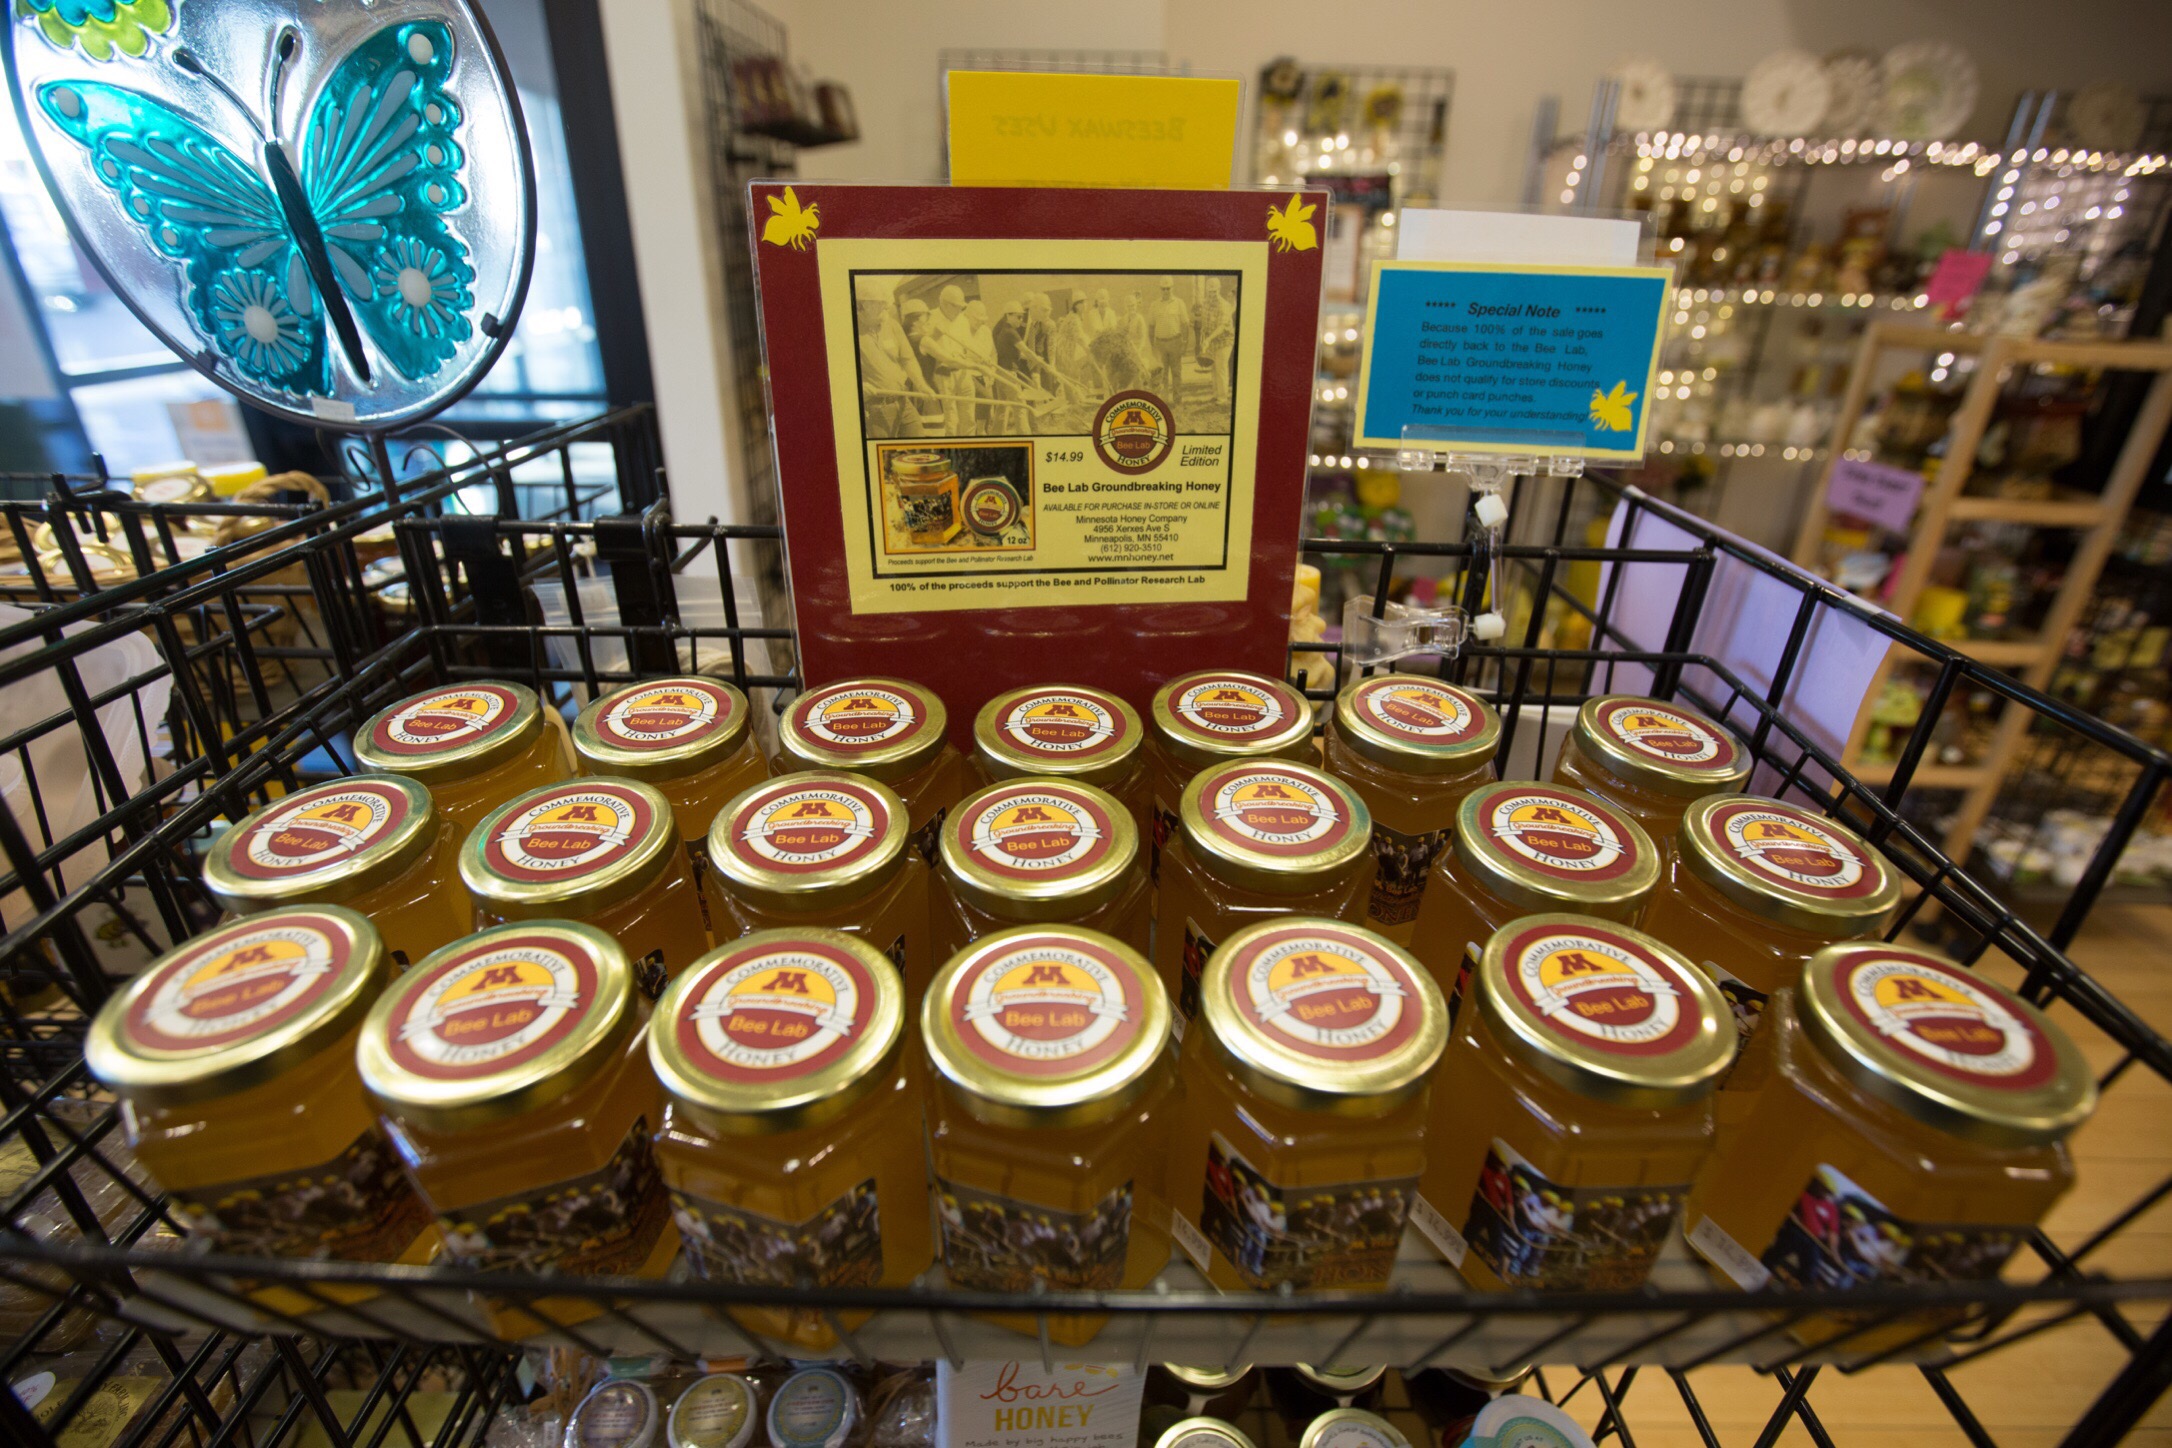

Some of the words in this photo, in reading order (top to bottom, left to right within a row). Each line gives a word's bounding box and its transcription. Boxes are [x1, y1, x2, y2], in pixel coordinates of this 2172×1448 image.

[1468, 302, 1522, 318] Special
[1525, 304, 1560, 318] Note
[1422, 322, 1467, 333] Because
[1475, 324, 1505, 335] 100%
[1512, 326, 1523, 335] of
[1529, 326, 1546, 336] the
[1553, 328, 1574, 338] sale
[1577, 330, 1603, 340] goes
[1420, 339, 1456, 351] directly
[1464, 341, 1488, 351] back
[1495, 342, 1505, 351] to
[1512, 342, 1528, 352] the
[1535, 343, 1555, 353] Bee
[1565, 345, 1587, 356] Lab,
[1418, 356, 1437, 365] Bee
[1441, 356, 1460, 366] Lab
[1466, 358, 1551, 372] Groundbreaking
[1558, 361, 1592, 374] Honey
[1415, 372, 1440, 382] does
[1444, 374, 1461, 383] not
[1464, 374, 1498, 386] qualify
[1502, 375, 1516, 385] for
[1519, 377, 1546, 386] store
[1550, 378, 1599, 389] discounts
[1426, 390, 1459, 402] punch
[1462, 391, 1485, 400] card
[1105, 401, 1162, 423] COMMEMORATIVE
[1412, 404, 1442, 415] Thank
[1444, 407, 1464, 417] you
[1468, 406, 1482, 416] for
[1485, 409, 1508, 419] your
[1510, 409, 1590, 423] understanding!
[1117, 441, 1133, 449] Bee
[1135, 441, 1150, 449] Lab
[1182, 445, 1221, 455] Limited
[1045, 451, 1083, 462] $14.99
[1117, 455, 1150, 466] HONEY
[1180, 456, 1219, 467] Edition
[1043, 483, 1064, 493] Bee
[1068, 483, 1088, 493] Lab
[1092, 482, 1182, 493] Groundbreaking
[1186, 481, 1221, 493] Honey
[1043, 503, 1082, 511] AVAILABLE
[1102, 502, 1142, 510] PURCHASE
[1144, 502, 1178, 510] IN-STORE
[1076, 515, 1118, 524] Minnesota
[1121, 515, 1146, 524] Honey
[1149, 514, 1187, 524] Company
[1093, 525, 1114, 533] 4956
[1146, 524, 1161, 532] Ave
[1164, 524, 1169, 532] S
[1084, 535, 1134, 543] Minneapolis,
[1137, 534, 1151, 542] MN
[1153, 534, 1178, 542] 55410
[1101, 544, 1122, 553] (612)
[1124, 544, 1162, 552] 920-3510
[1088, 553, 1173, 563] www.mnhoney.net
[890, 583, 915, 591] 100%
[920, 582, 929, 590] of
[931, 582, 946, 590] the
[949, 580, 993, 591] proceeds
[996, 580, 1034, 589] support
[1036, 578, 1050, 587] the
[1053, 578, 1071, 586] Bee
[1074, 578, 1091, 586] and
[1094, 577, 1138, 585] Pollinator
[1141, 576, 1185, 584] Research
[1188, 575, 1205, 583] Lab
[626, 686, 714, 705] COMMEMORATIVE
[1188, 682, 1272, 702] COMMEMORATIVE
[816, 690, 904, 710] COMMEMORATIVE
[1019, 696, 1105, 717] COMMEMORATIVE
[631, 717, 655, 726] Bee
[660, 717, 683, 726] Lab
[1204, 711, 1228, 721] Bee
[1233, 711, 1256, 721] Lab
[833, 721, 858, 730] Bee
[863, 721, 886, 729] Lab
[1032, 727, 1056, 736] Bee
[1061, 728, 1085, 738] Lab
[1206, 722, 1257, 733] HONEY
[623, 729, 677, 741] HONEY
[832, 732, 887, 744] HONEY
[1030, 741, 1084, 752] HONEY
[1222, 774, 1319, 799] COMMEMORATIVE
[529, 795, 630, 819] COMMEMORATIVE
[760, 791, 865, 815] COMMEMORATIVE
[980, 795, 1082, 825] COMMEMORATIVE
[1248, 814, 1277, 825] Bee
[1281, 813, 1309, 825] Lab
[1499, 796, 1602, 828] COMMEMORATIVE
[528, 838, 557, 849] Bee
[562, 837, 591, 849] Lab
[776, 833, 806, 845] Bee
[811, 832, 839, 844] Lab
[1007, 840, 1037, 852] Bee
[1041, 836, 1070, 849] Lab
[1252, 830, 1312, 845] HONEY
[1528, 835, 1557, 848] Bee
[1562, 838, 1592, 853] Lab
[517, 855, 582, 869] HONEY
[773, 849, 838, 864] HONEY
[1011, 853, 1075, 869] HONEY
[1533, 852, 1597, 870] HONEY
[1578, 996, 1614, 1017] Bee
[1618, 993, 1649, 1012] Lab
[980, 1359, 1119, 1402] bare
[995, 1404, 1094, 1431] HONEY
[1026, 1438, 1044, 1447] big
[1051, 1435, 1088, 1444] happy
[1094, 1433, 1124, 1441] bees
